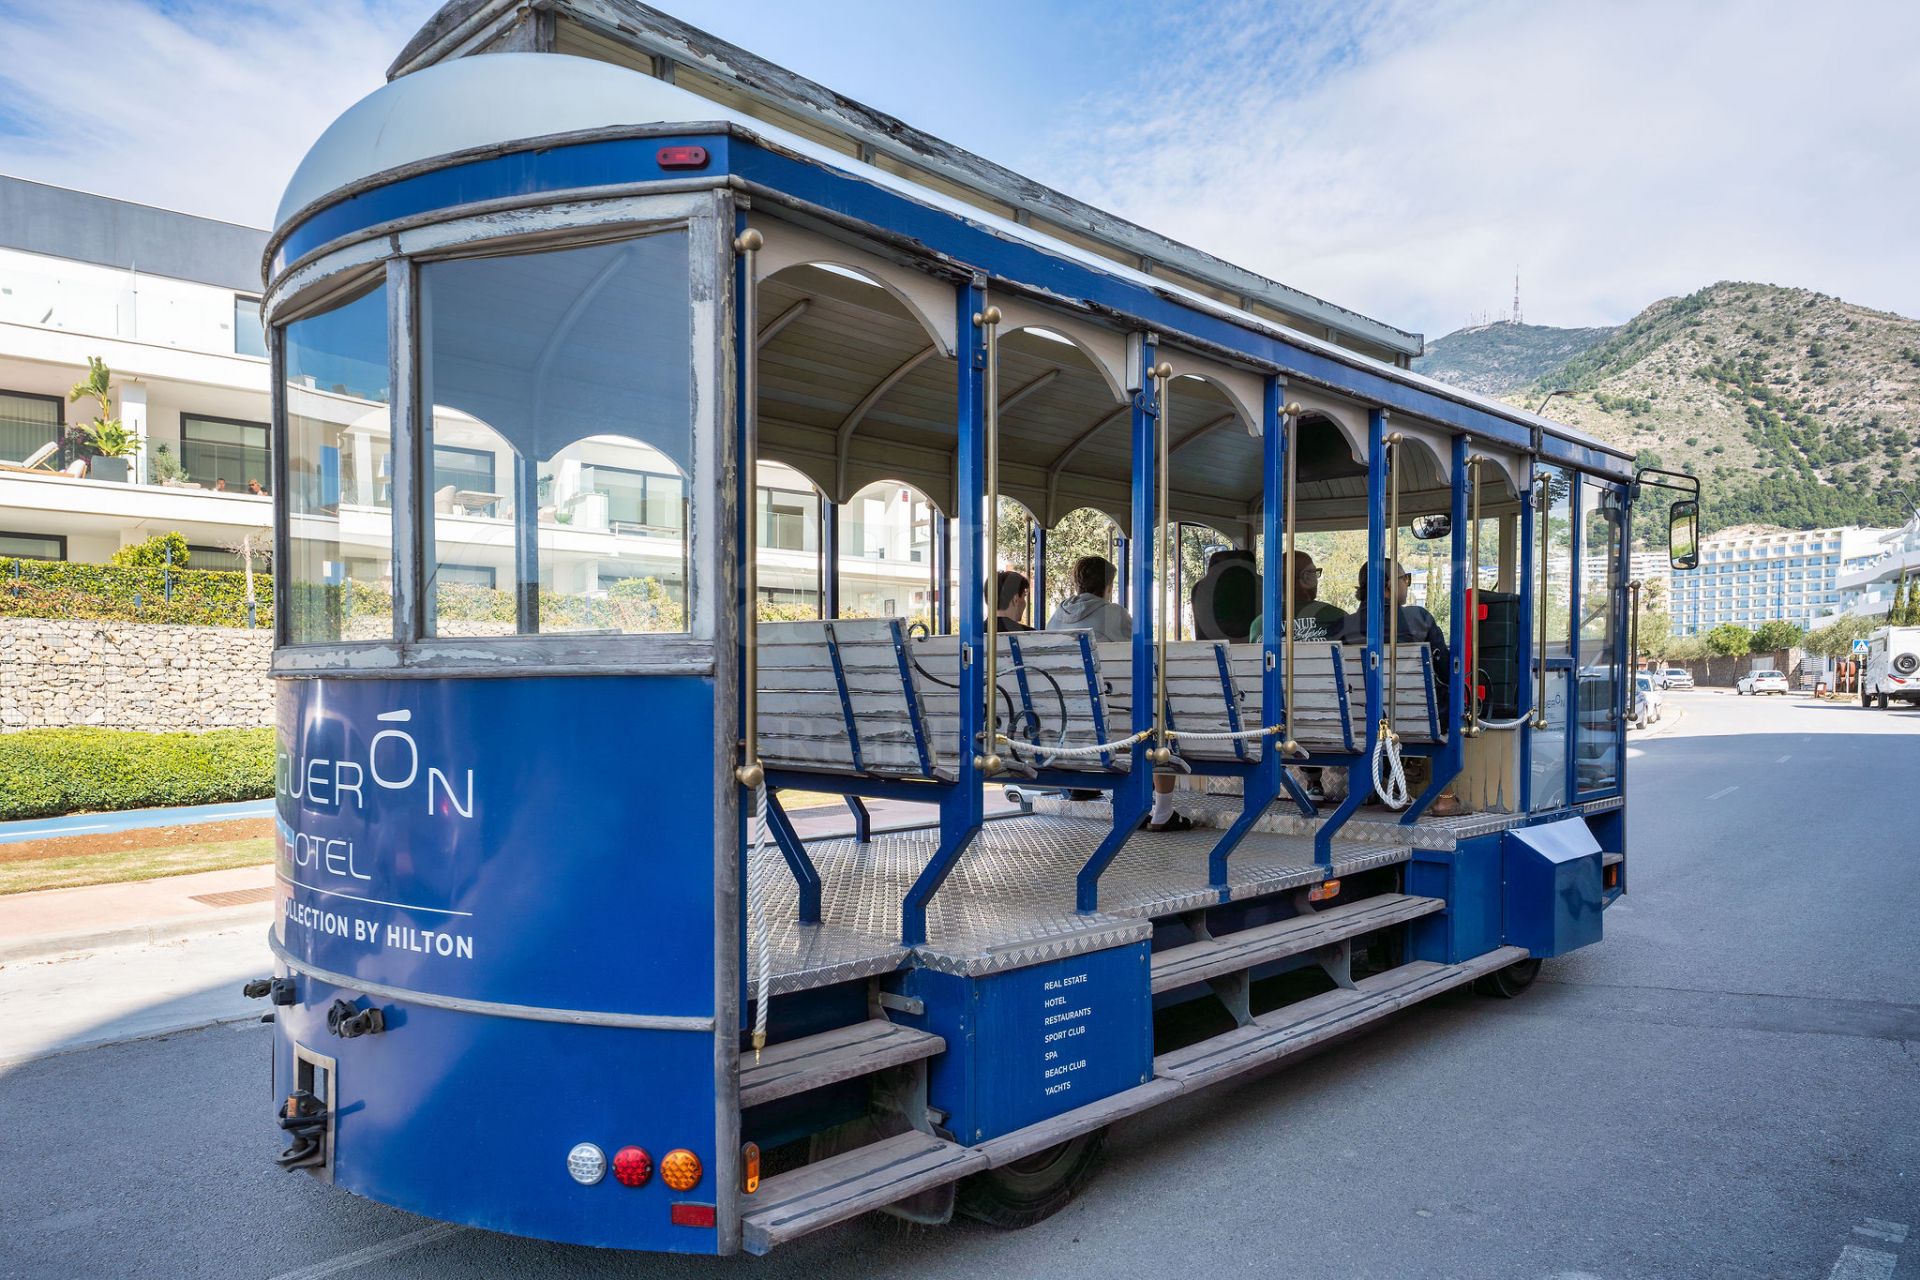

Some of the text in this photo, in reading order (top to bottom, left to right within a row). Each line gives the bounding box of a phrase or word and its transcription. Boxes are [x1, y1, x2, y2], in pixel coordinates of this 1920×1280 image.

[282, 895, 473, 960] OLLECTION BY HILTON
[1044, 973, 1087, 990] REAL ESTATE
[1044, 996, 1066, 1008] HOTEL
[1044, 1007, 1091, 1025] RESTAURANTS
[1044, 1025, 1085, 1043] SPORT CLUB
[1044, 1050, 1058, 1060] SPA
[1044, 1059, 1086, 1078] BEACH CLUB
[1044, 1081, 1070, 1095] YACHTS
